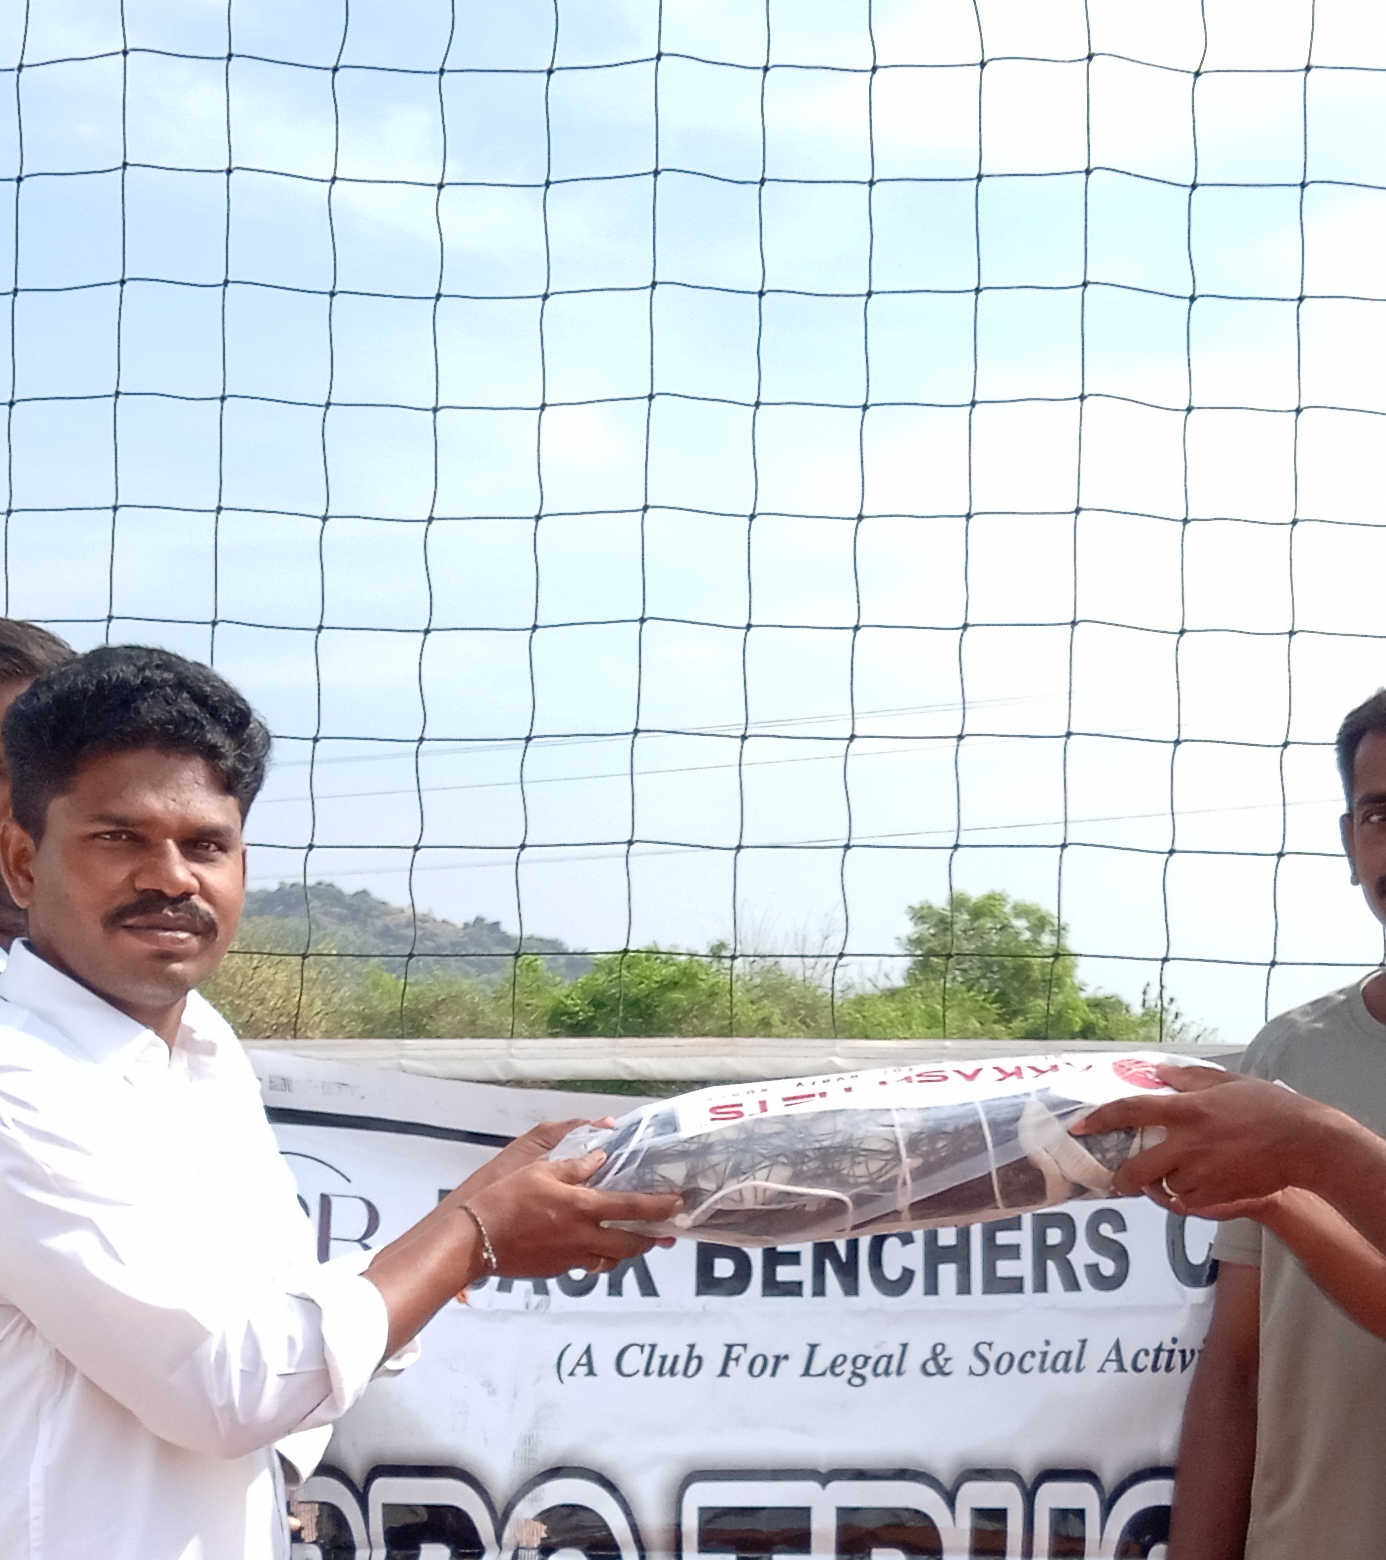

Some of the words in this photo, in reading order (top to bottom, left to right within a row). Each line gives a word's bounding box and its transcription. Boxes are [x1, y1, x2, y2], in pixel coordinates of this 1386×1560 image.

[695, 1207, 1131, 1298] BENCHERS
[556, 1342, 598, 1384] (A
[614, 1342, 704, 1379] Club
[717, 1342, 790, 1379] For
[800, 1341, 910, 1388] Legal
[919, 1341, 954, 1378] &
[968, 1338, 1089, 1377] Social
